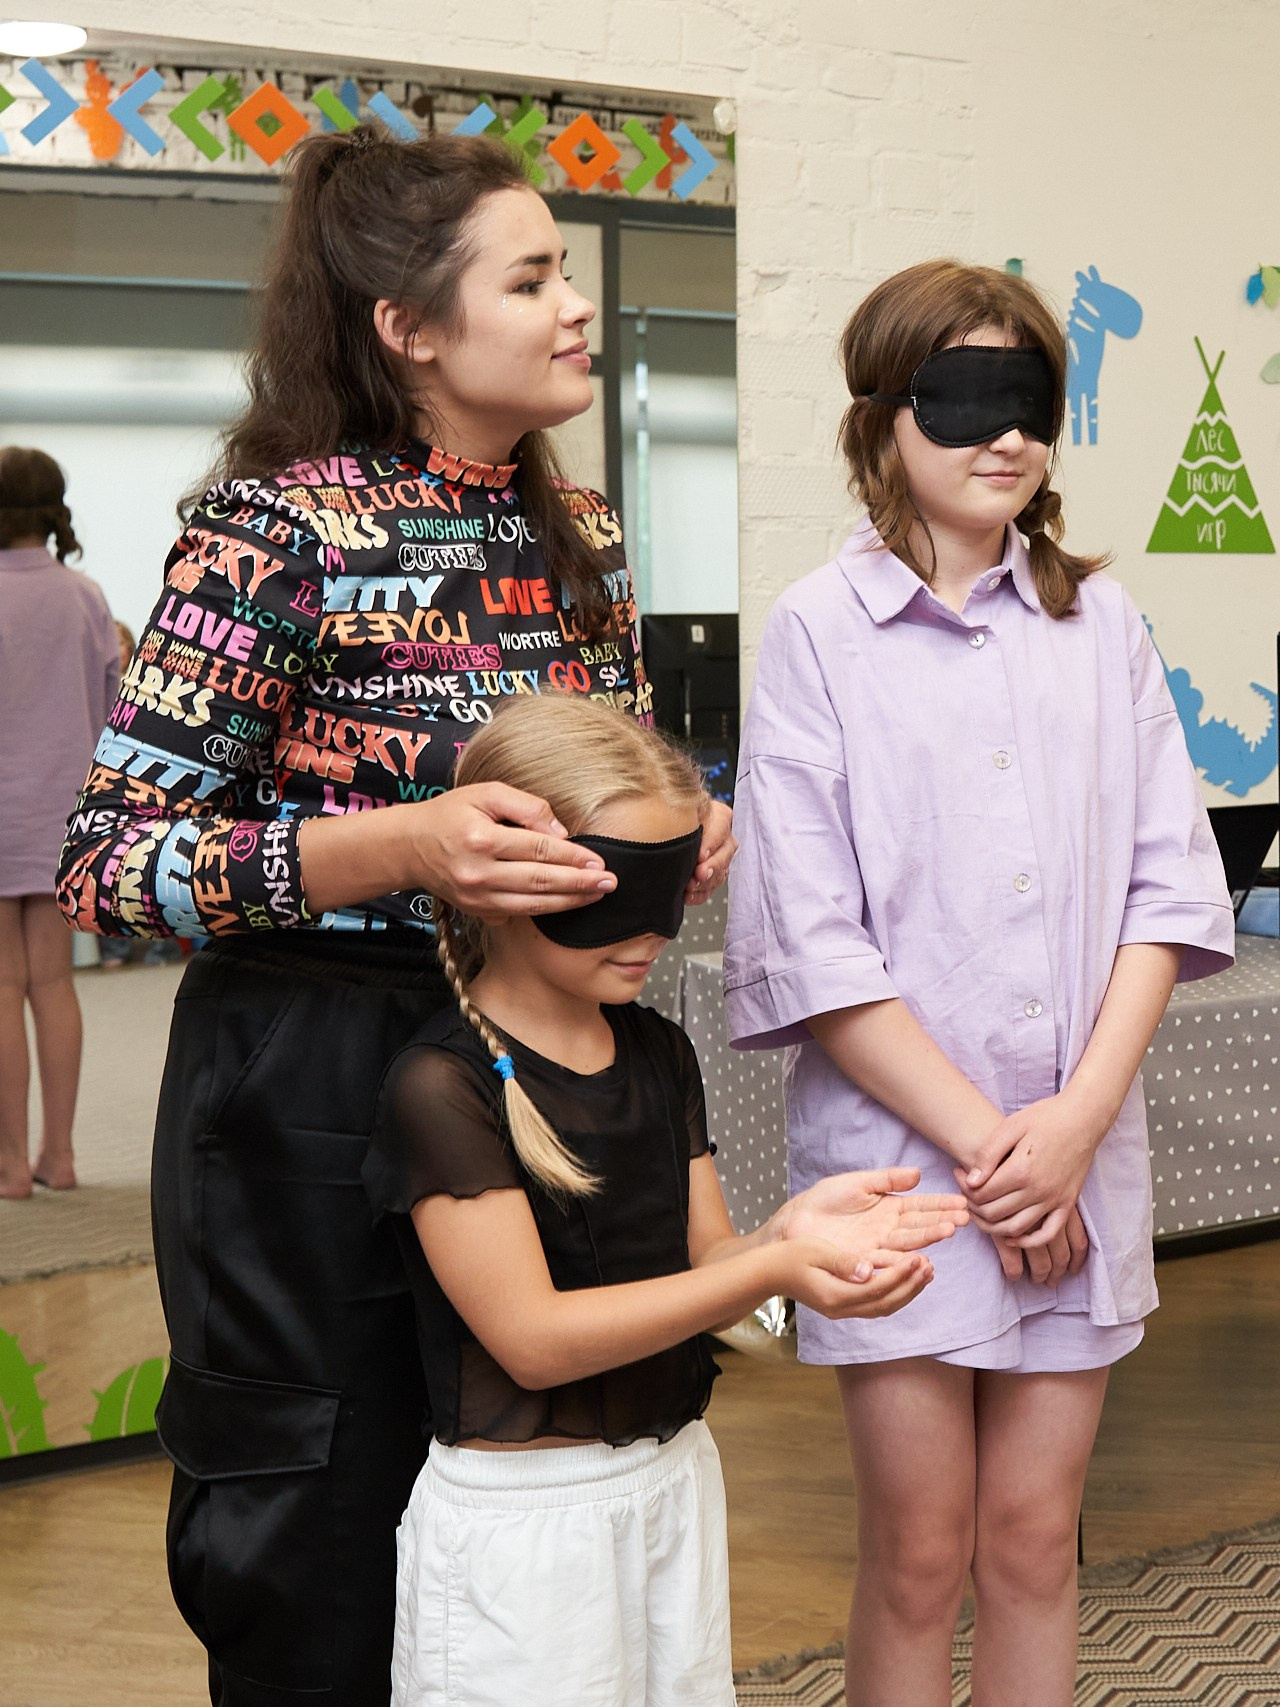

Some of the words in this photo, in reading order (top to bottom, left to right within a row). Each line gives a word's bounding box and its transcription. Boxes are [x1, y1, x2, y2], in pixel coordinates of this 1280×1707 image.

[426, 446, 519, 488] WINS
[228, 505, 315, 556] BABY
[398, 517, 486, 540] SUNSHINE
[176, 527, 286, 600] UCKY
[398, 543, 487, 571] CUTIES
[479, 577, 554, 616] LOVE
[157, 594, 259, 662] LOVE
[380, 642, 504, 672] CUTIES
[579, 641, 623, 666] BABY
[202, 655, 300, 714] LUCK
[305, 672, 467, 702] UNSHINE
[466, 669, 541, 697] LUCKY
[547, 660, 592, 694] GO
[449, 698, 494, 724] GO
[279, 700, 432, 781] LUCKY
